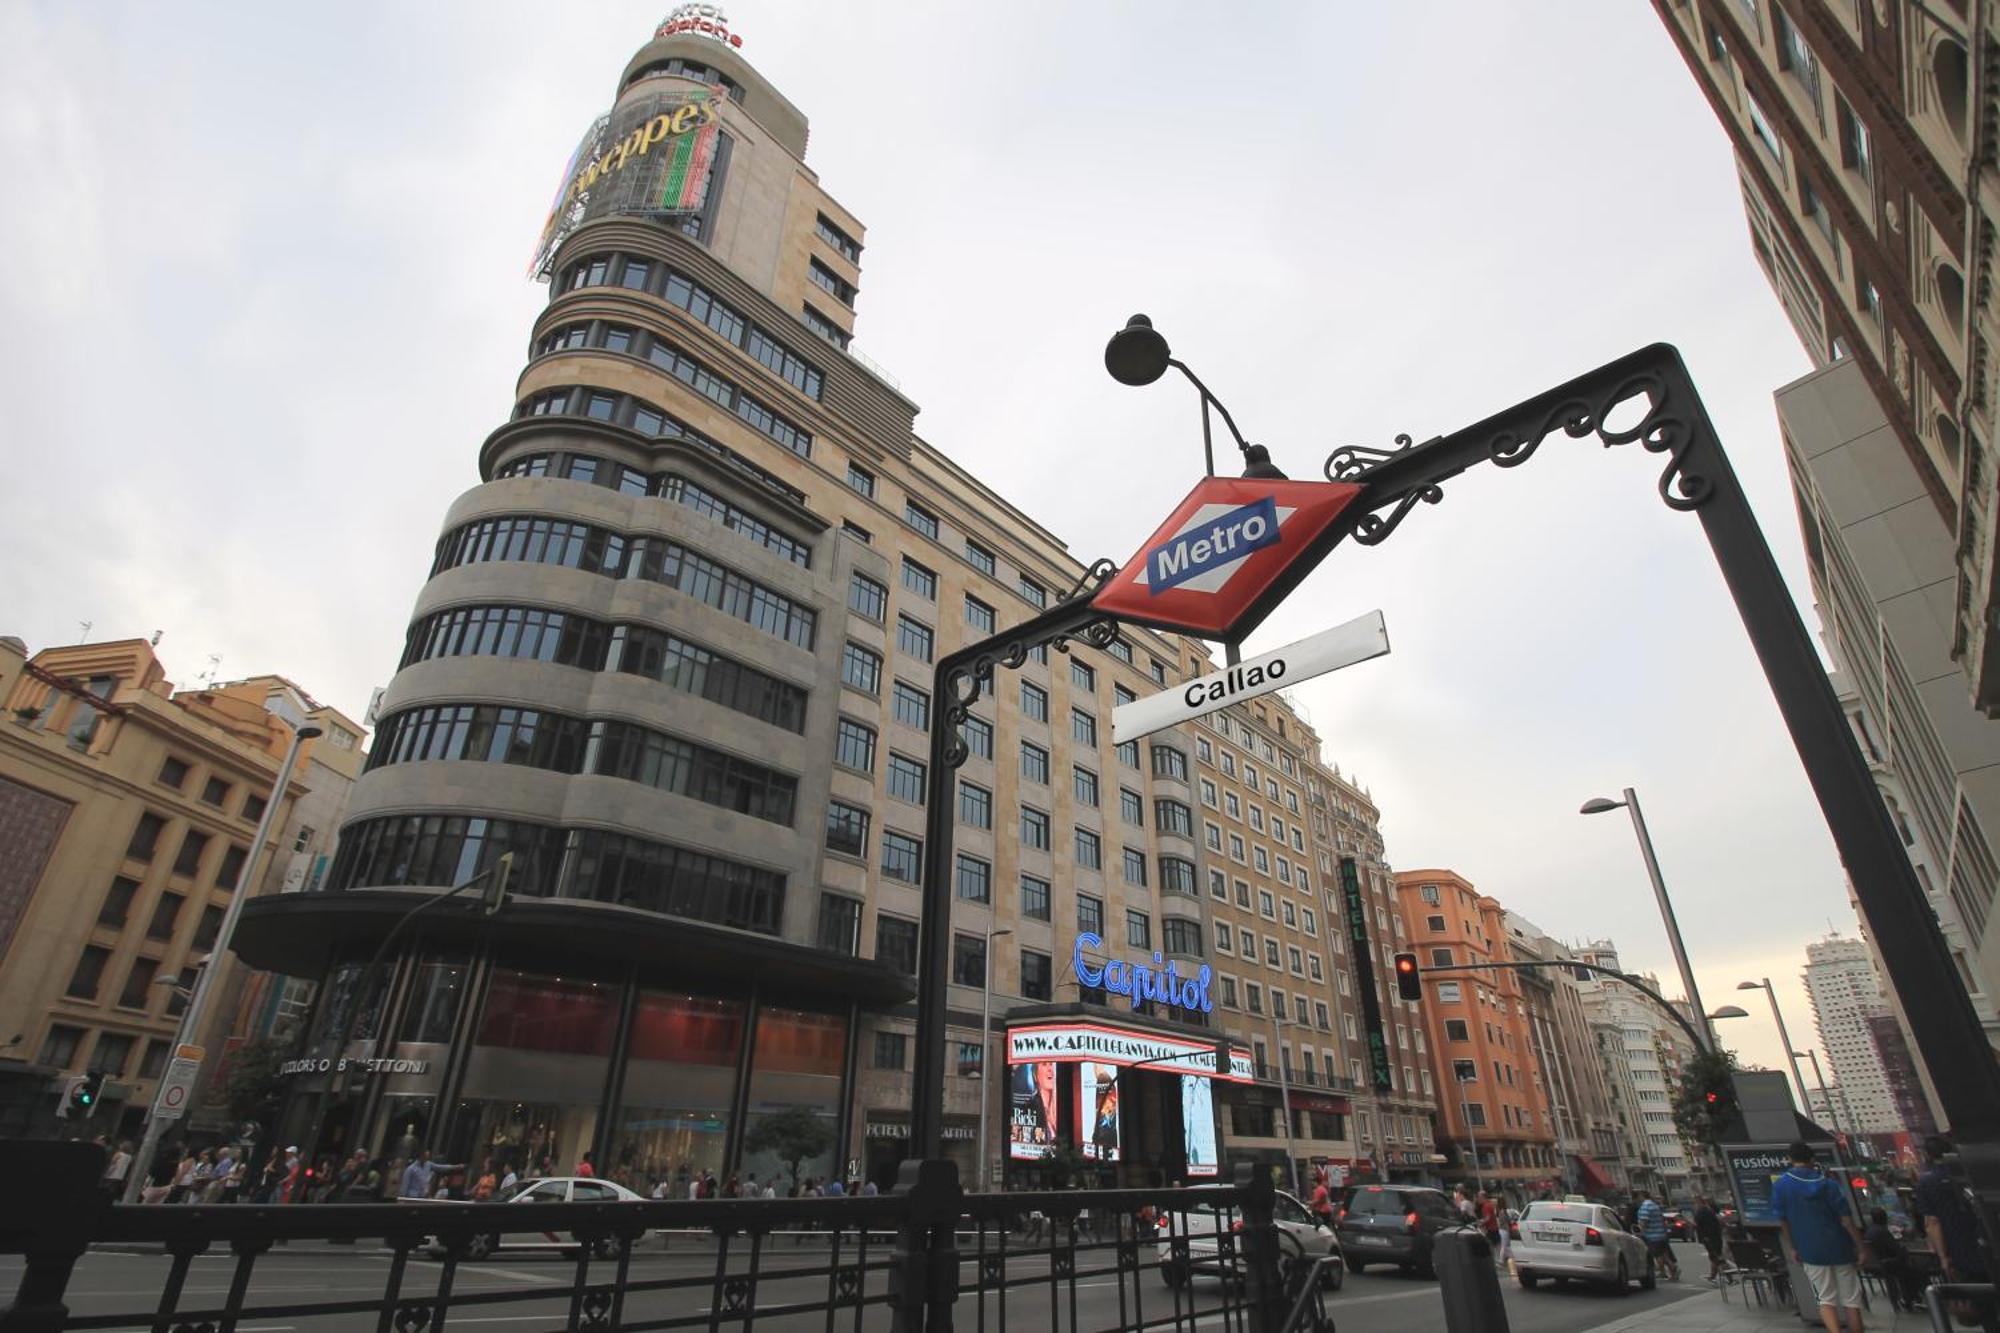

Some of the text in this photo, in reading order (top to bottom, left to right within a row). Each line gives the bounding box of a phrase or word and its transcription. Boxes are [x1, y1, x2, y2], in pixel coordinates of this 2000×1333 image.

[1158, 515, 1267, 580] Metro
[1185, 658, 1286, 708] Callao
[1343, 863, 1364, 940] HOTEL
[1072, 931, 1213, 1013] Capitol
[1370, 1032, 1389, 1085] REX
